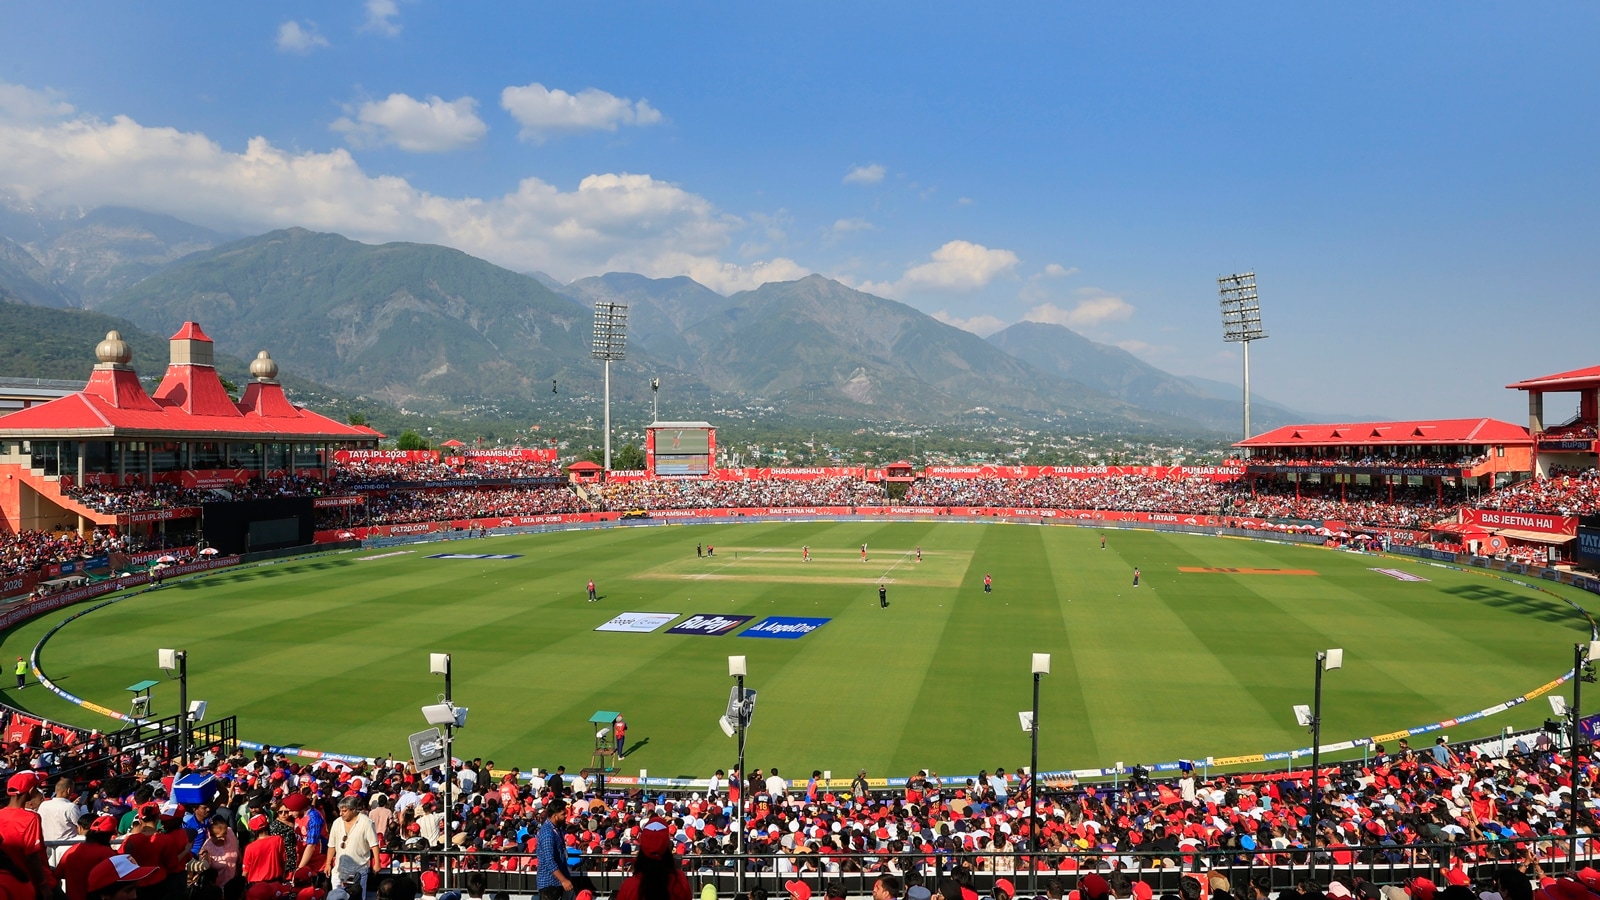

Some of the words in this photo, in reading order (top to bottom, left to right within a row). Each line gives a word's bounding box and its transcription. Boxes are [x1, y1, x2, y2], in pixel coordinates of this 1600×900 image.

[1562, 442, 1587, 450] RuPay
[1482, 513, 1500, 523] BAS
[1501, 515, 1534, 527] JEETNA
[1536, 519, 1553, 528] HAI
[1394, 532, 1414, 540] 2026
[131, 549, 191, 565] DHARAMALA
[209, 557, 240, 568] @FREEMANS
[176, 562, 208, 574] @FREEMANS
[4, 579, 23, 591] 2026
[88, 582, 116, 595] @FREEMANS
[60, 590, 87, 603] @FREEMANS
[31, 598, 59, 613] @FREEMANS
[674, 616, 736, 634] RuPay
[762, 622, 816, 634] AngelOne
